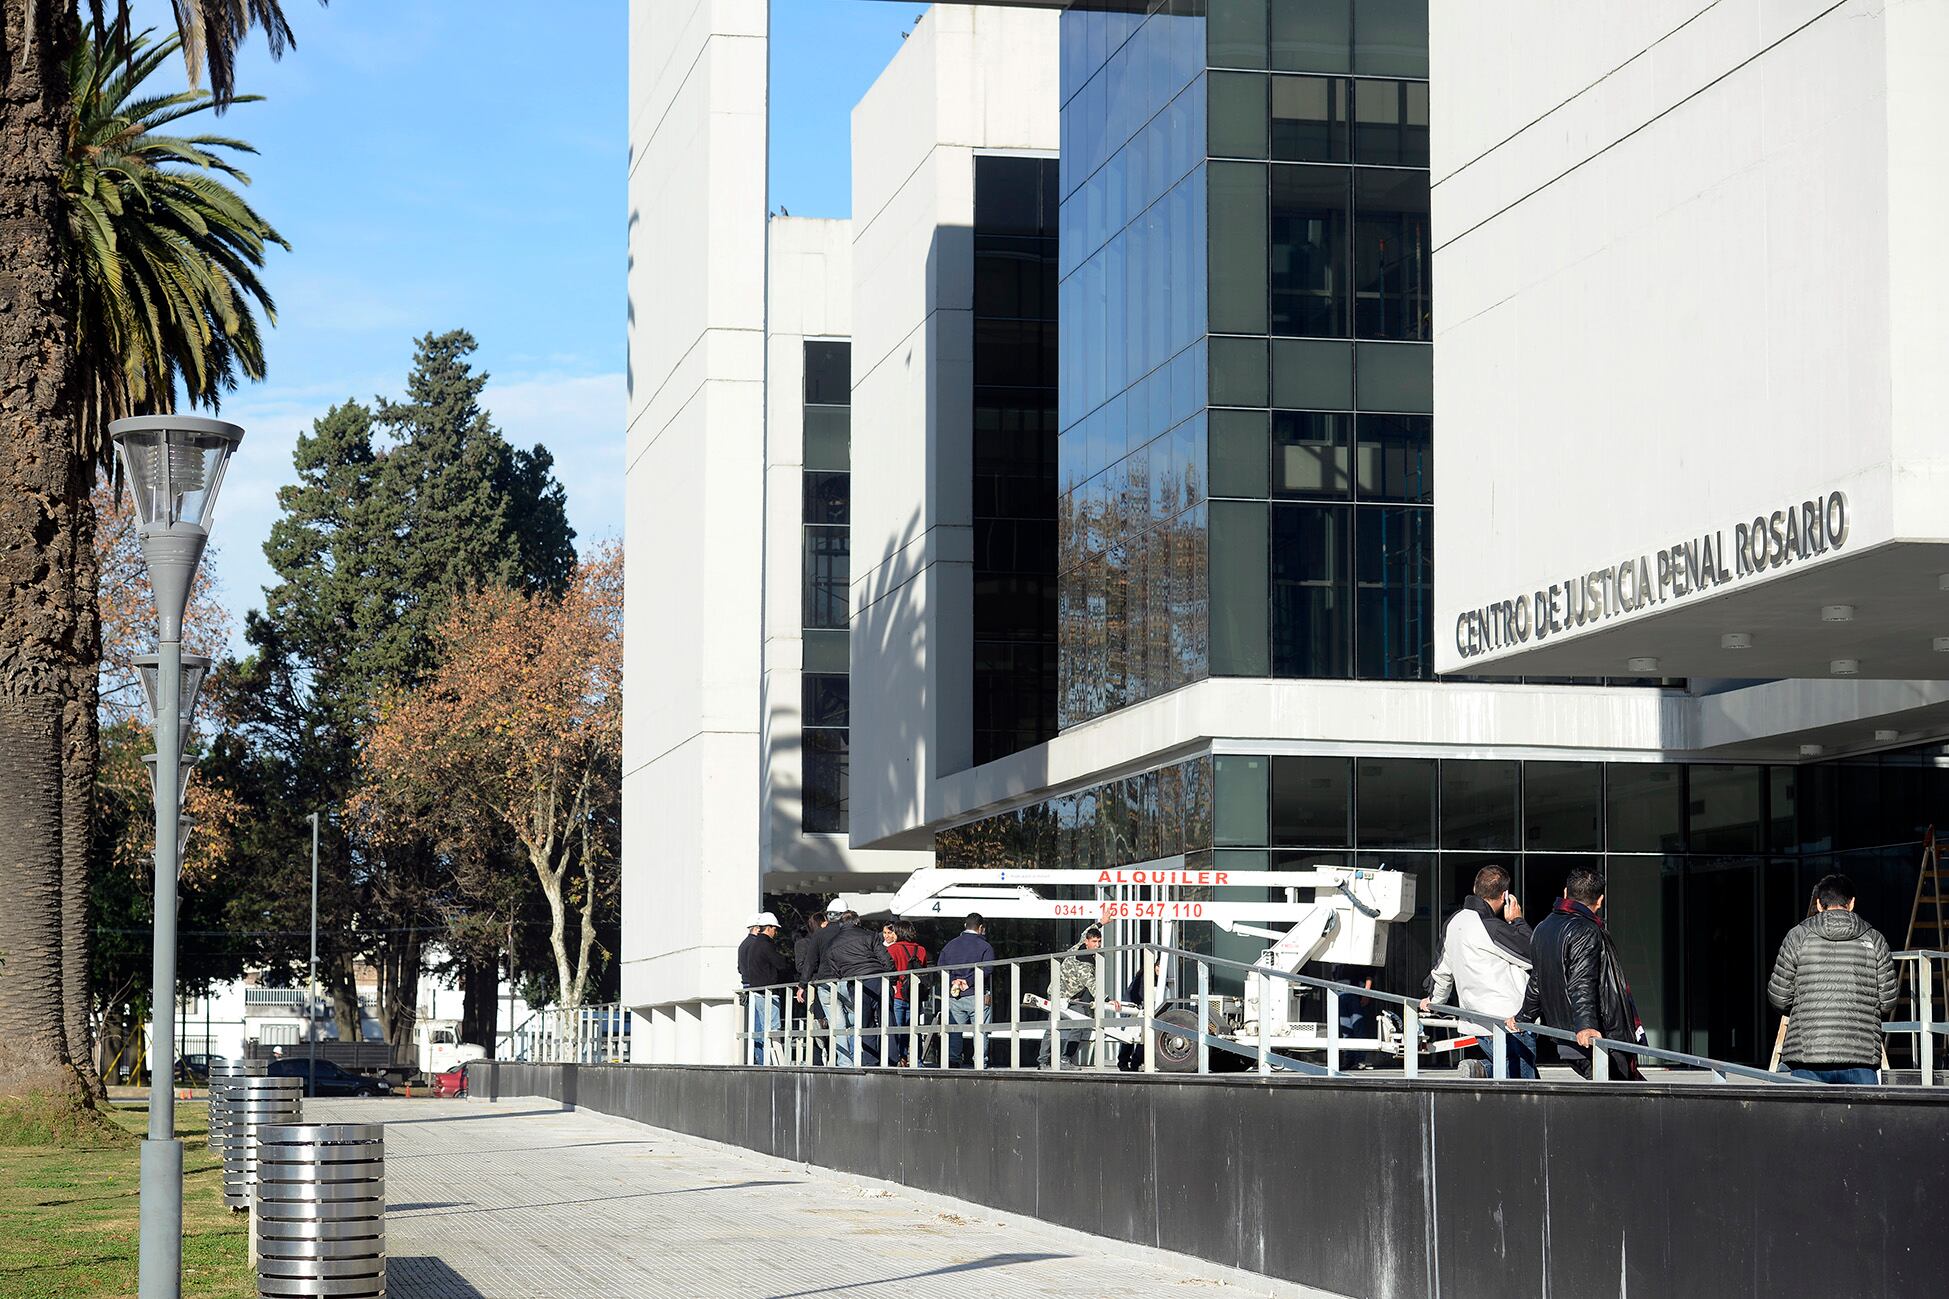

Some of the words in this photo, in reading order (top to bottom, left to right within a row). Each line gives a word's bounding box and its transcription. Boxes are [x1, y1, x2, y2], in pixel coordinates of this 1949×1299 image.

[1456, 594, 1532, 658] CENTRO
[1535, 584, 1562, 640] DE
[1564, 555, 1656, 630] JUSTICIA
[1657, 530, 1733, 604] PENAL
[1735, 490, 1850, 580] ROSARIO
[1098, 871, 1228, 885] ALQUILER
[932, 901, 941, 913] 4
[1054, 904, 1084, 916] 0341
[1099, 902, 1129, 917] 156
[1135, 903, 1165, 918] 547
[1172, 903, 1203, 918] 110
